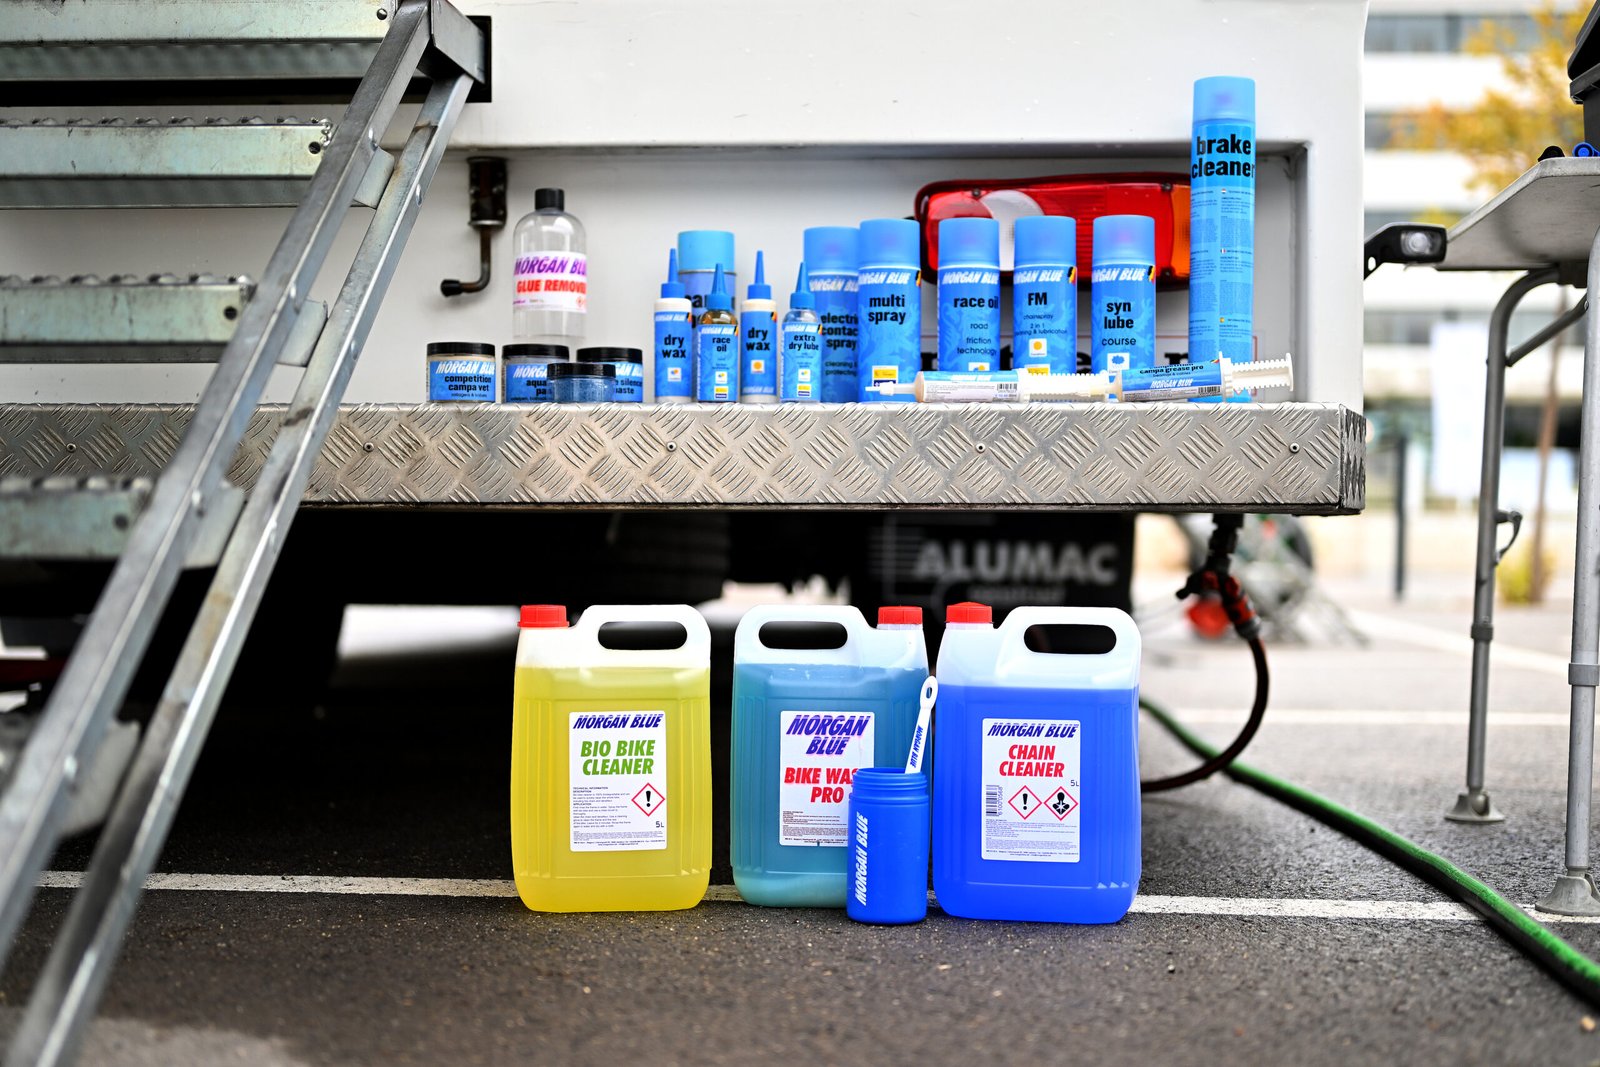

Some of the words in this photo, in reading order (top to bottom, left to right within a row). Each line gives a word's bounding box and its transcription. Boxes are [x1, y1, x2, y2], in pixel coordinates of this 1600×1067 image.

[1197, 134, 1252, 156] brake
[514, 256, 569, 276] MORGAN
[1039, 269, 1064, 283] BLUE
[1119, 267, 1146, 281] BLUE
[517, 280, 541, 294] GLUE
[869, 294, 906, 308] multi
[954, 297, 985, 308] race
[988, 296, 999, 309] oil
[1028, 292, 1048, 306] FM
[1106, 301, 1132, 316] syn
[868, 311, 906, 325] spray
[1104, 316, 1134, 329] lube
[747, 328, 768, 341] dry
[793, 334, 816, 342] extra
[966, 337, 992, 345] friction
[1101, 337, 1137, 346] course
[664, 335, 685, 349] dry
[716, 344, 727, 352] oil
[745, 342, 771, 352] wax
[788, 342, 803, 351] dry
[826, 339, 857, 351] spray
[662, 349, 687, 359] wax
[957, 347, 997, 357] technology
[435, 361, 480, 374] MORGAN
[1139, 367, 1164, 375] campa
[1164, 365, 1191, 374] grease
[1191, 363, 1204, 371] pro
[444, 373, 492, 384] competition
[1149, 380, 1178, 389] MORGAN
[448, 384, 477, 393] campa
[478, 384, 490, 392] vet
[910, 541, 1118, 585] ALUMAC
[573, 714, 631, 729] MORGAN
[630, 713, 664, 728] BLUE
[786, 714, 871, 736] MORGAN
[987, 722, 1046, 738] MORGAN
[1044, 723, 1079, 738] BLUE
[580, 740, 611, 757] BIO
[615, 739, 656, 756] BIKE
[806, 736, 850, 755] BLUE
[1008, 744, 1056, 761] CHAIN
[582, 758, 654, 776] CLEANER
[999, 761, 1065, 778] CLEANER
[784, 767, 822, 784] BIKE
[810, 787, 845, 803] PRO
[856, 811, 868, 849] BLUE
[854, 845, 868, 906] MORGAN
